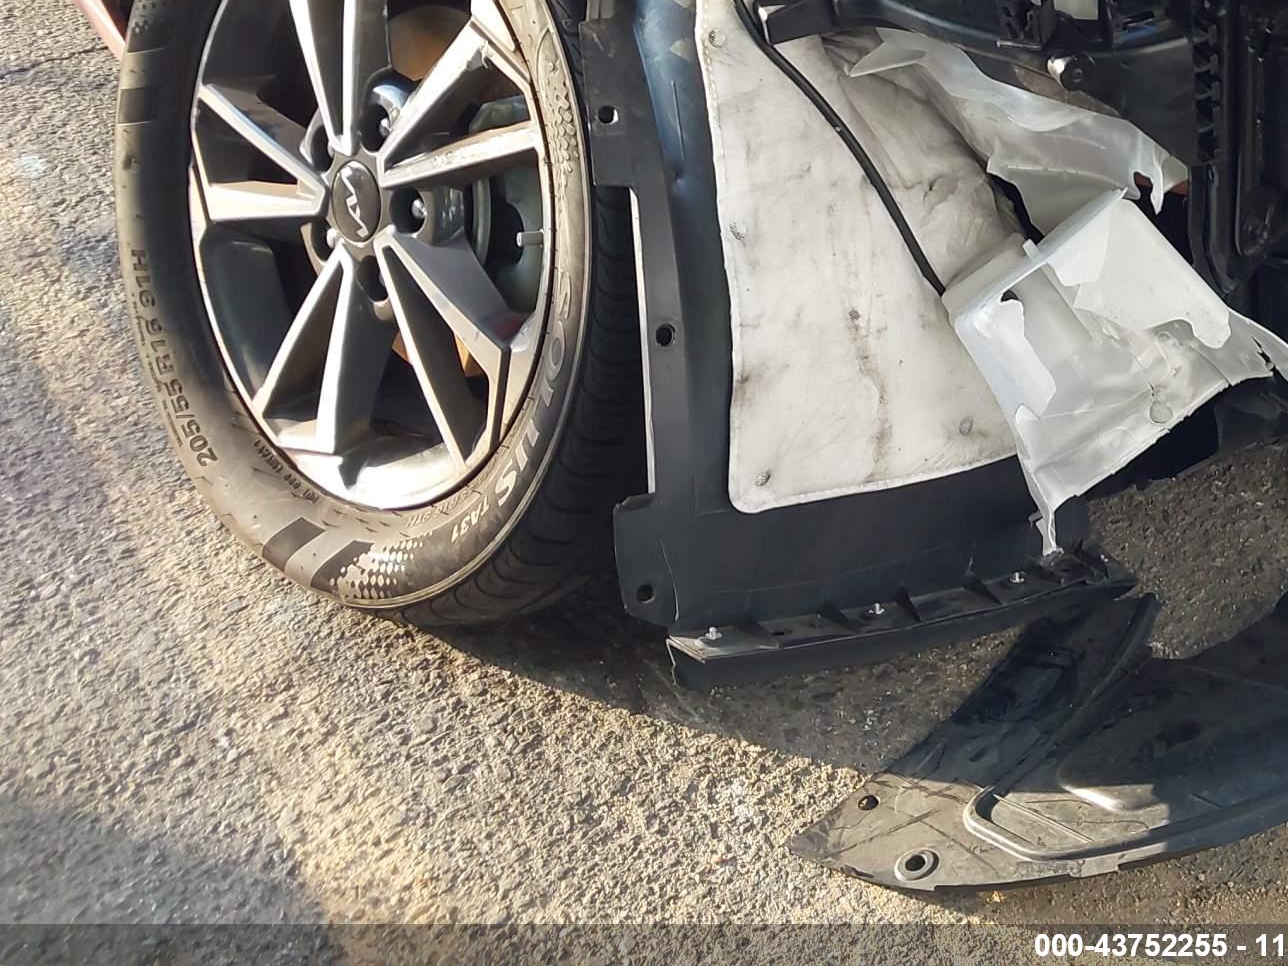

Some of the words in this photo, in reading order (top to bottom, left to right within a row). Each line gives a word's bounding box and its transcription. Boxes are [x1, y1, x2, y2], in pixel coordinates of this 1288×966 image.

[131, 249, 156, 308] 91H
[167, 377, 218, 467] 205/55
[495, 271, 572, 507] SOLUS
[450, 494, 490, 542] TA31
